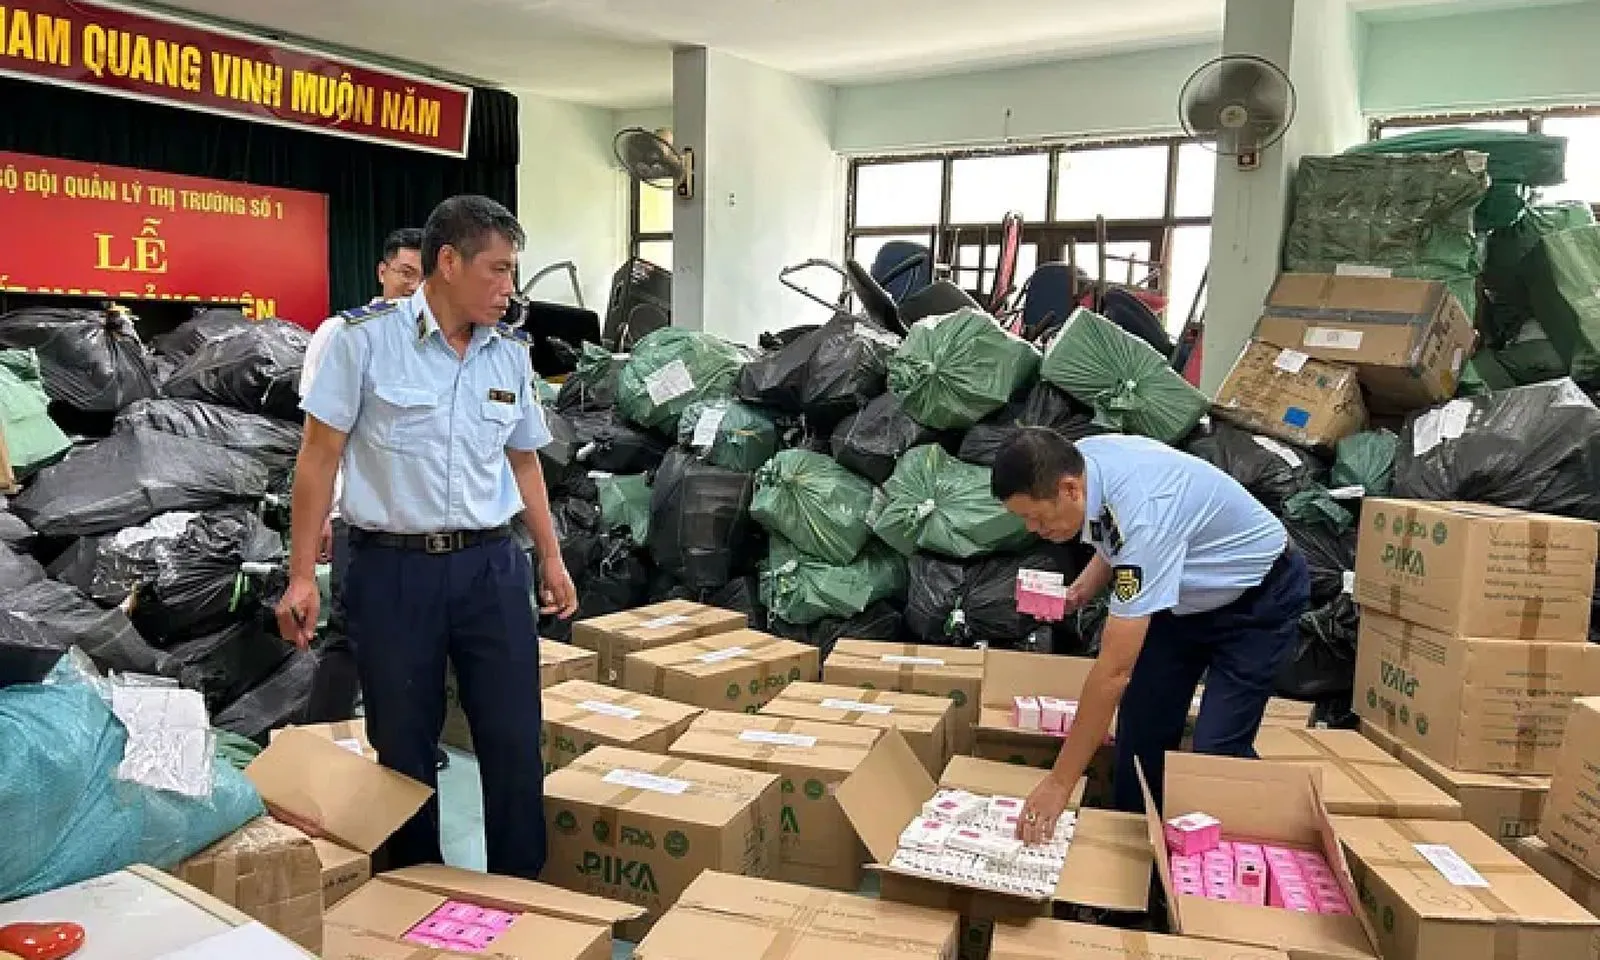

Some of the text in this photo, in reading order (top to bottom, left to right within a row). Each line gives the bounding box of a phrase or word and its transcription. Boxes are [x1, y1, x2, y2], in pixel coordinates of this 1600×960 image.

[83, 23, 201, 92] QUANG
[211, 51, 283, 107] VINH
[291, 70, 374, 125] MUÔN
[381, 87, 441, 137] NĂM
[0, 164, 283, 220] Ộ ĐỘI QUẢN LÝ THỊ TRƯỜNG SỐ 1
[93, 218, 168, 274] LỄ
[577, 851, 660, 894] PIKA
